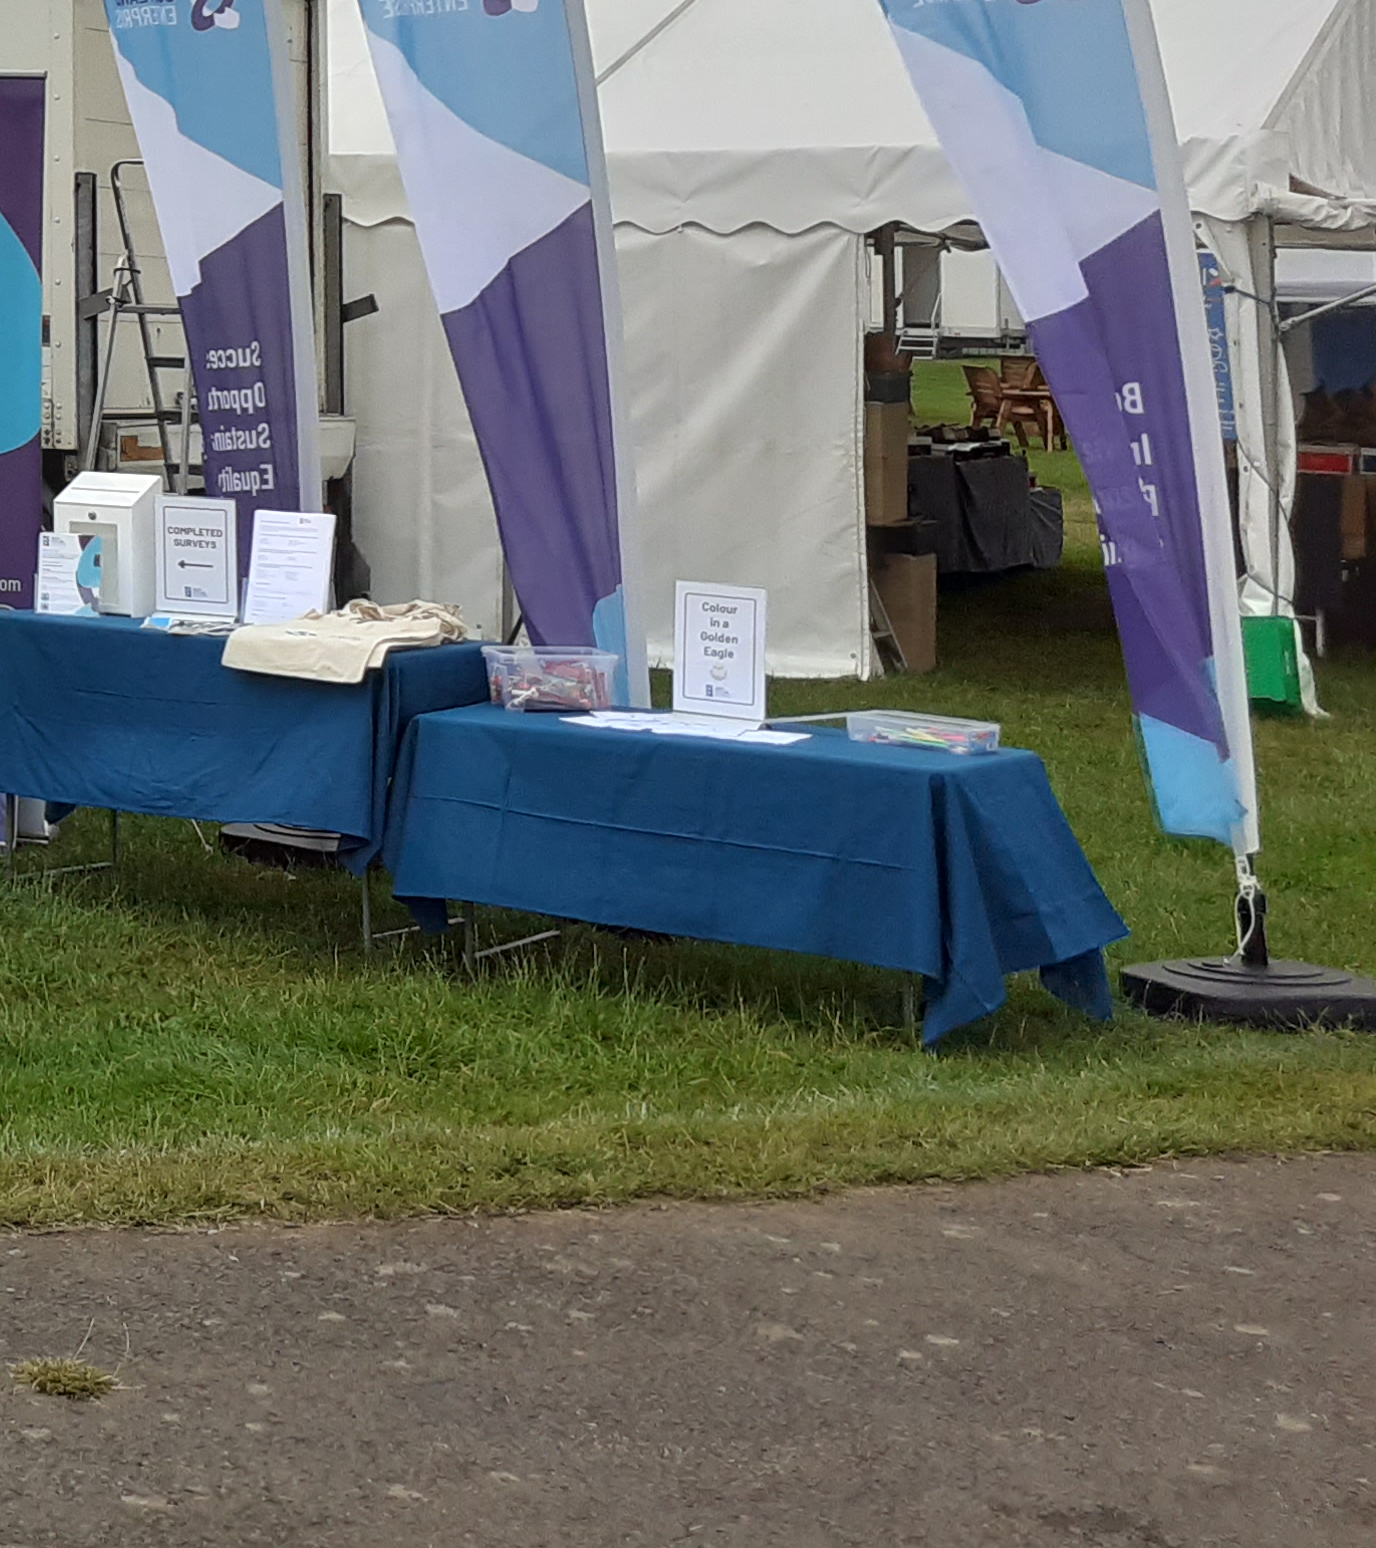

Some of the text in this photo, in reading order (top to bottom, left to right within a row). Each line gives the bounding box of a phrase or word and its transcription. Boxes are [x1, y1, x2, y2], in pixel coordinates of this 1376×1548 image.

[167, 526, 223, 539] COMPLETED
[173, 538, 217, 550] SURVEYS
[701, 601, 738, 614] Colour
[710, 617, 730, 629] in a
[700, 631, 739, 644] Golden
[703, 646, 735, 660] Eagle
